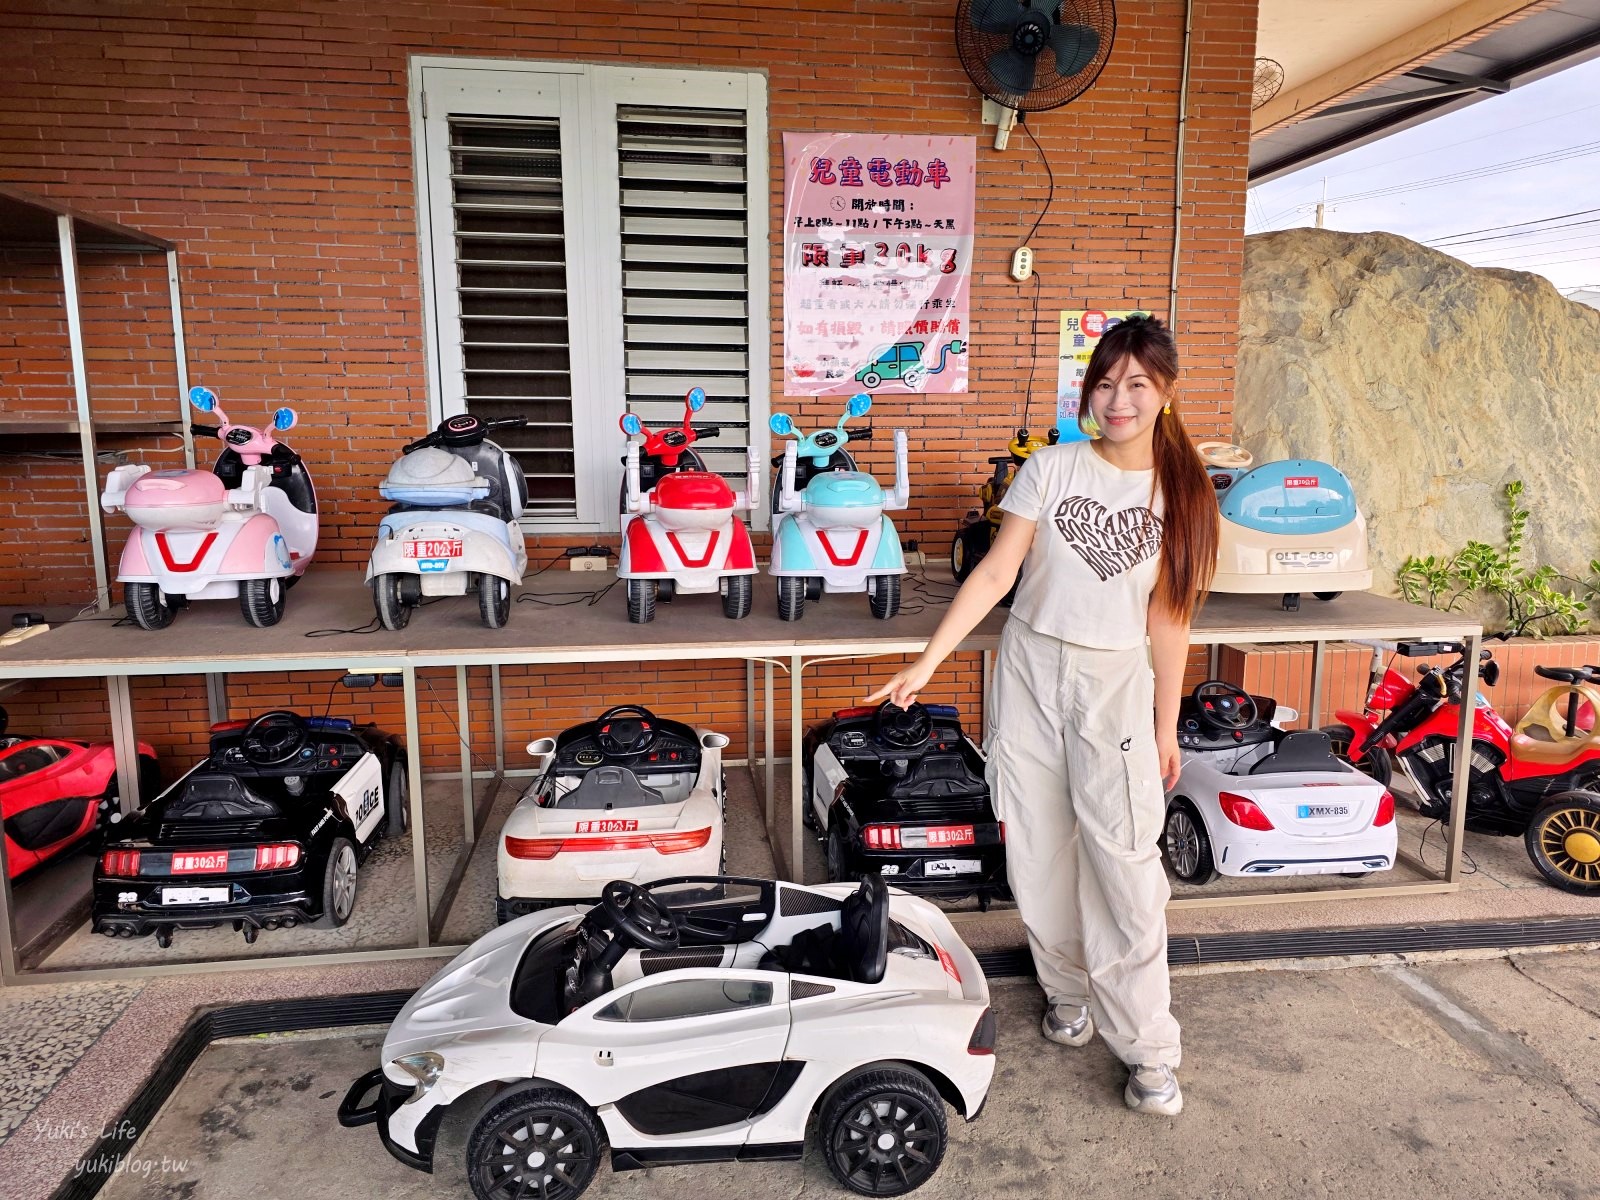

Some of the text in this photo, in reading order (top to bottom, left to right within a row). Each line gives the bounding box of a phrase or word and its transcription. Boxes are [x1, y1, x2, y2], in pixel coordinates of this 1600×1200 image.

[809, 156, 951, 189] 兒童電動車
[403, 539, 463, 558] 限重20公斤
[1309, 806, 1348, 816] XMX-835
[577, 820, 637, 833] 限重30公斤
[928, 829, 973, 843] 限重30公斤
[173, 855, 227, 871] 限重30公斤
[881, 864, 899, 875] 23
